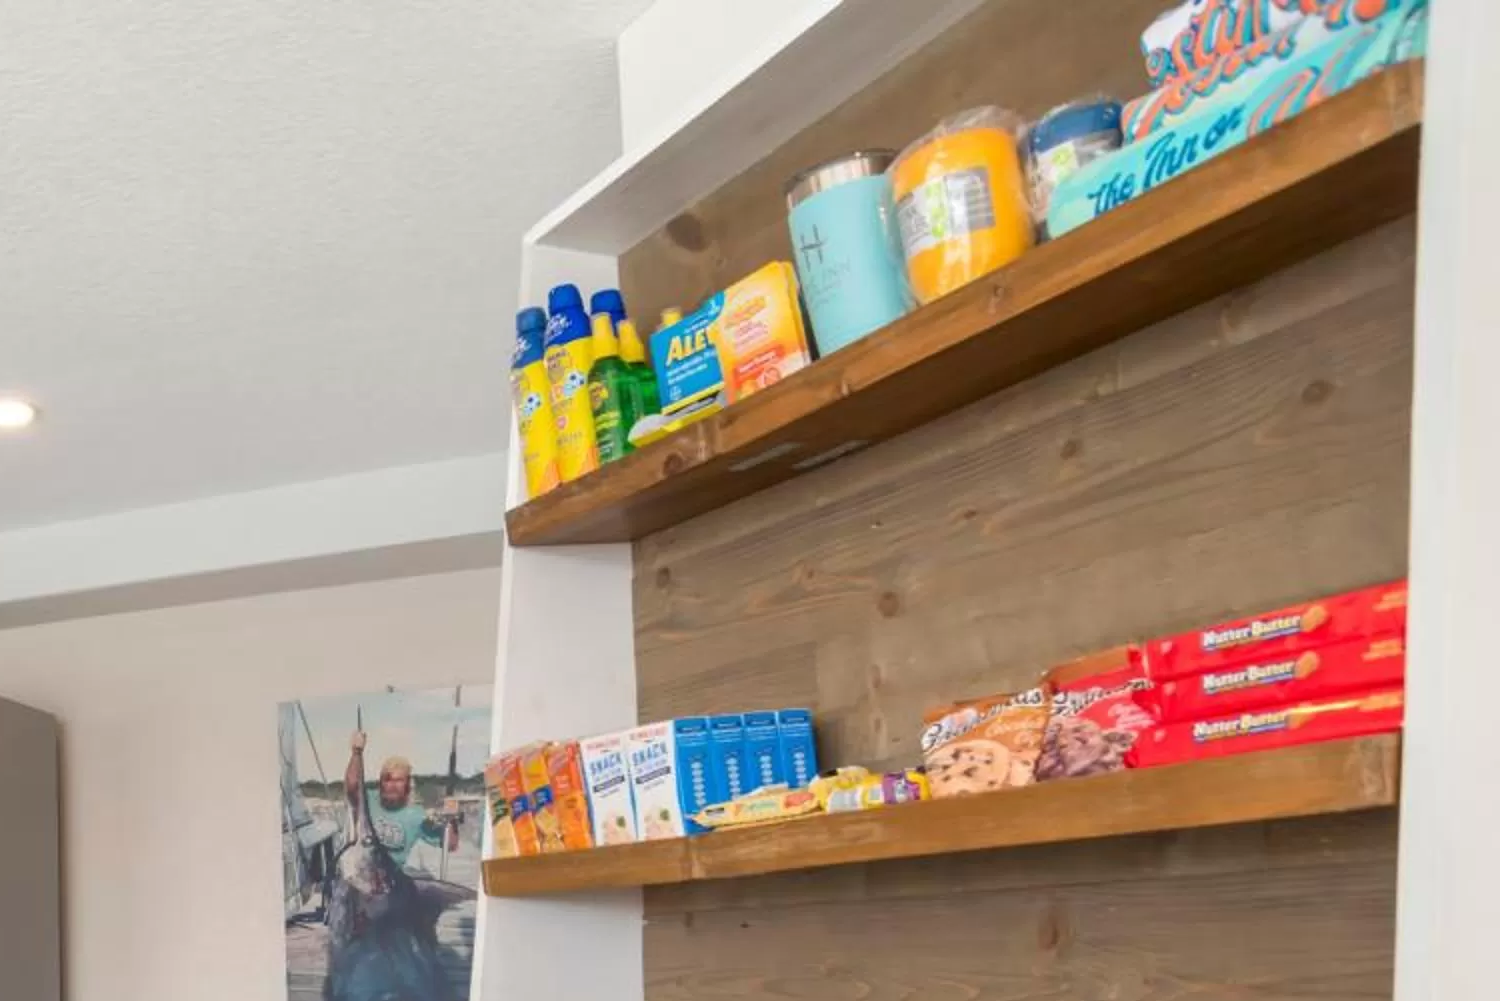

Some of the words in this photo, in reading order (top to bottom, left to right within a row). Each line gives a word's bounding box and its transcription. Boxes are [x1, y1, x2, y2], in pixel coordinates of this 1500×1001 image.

[665, 327, 709, 368] ALE
[1203, 626, 1250, 651] Nutter
[1251, 614, 1301, 640] Butter
[1203, 672, 1248, 695] Nutter
[1248, 660, 1296, 684] Butter
[1193, 718, 1241, 743] Nutter
[1240, 708, 1290, 733] Butter
